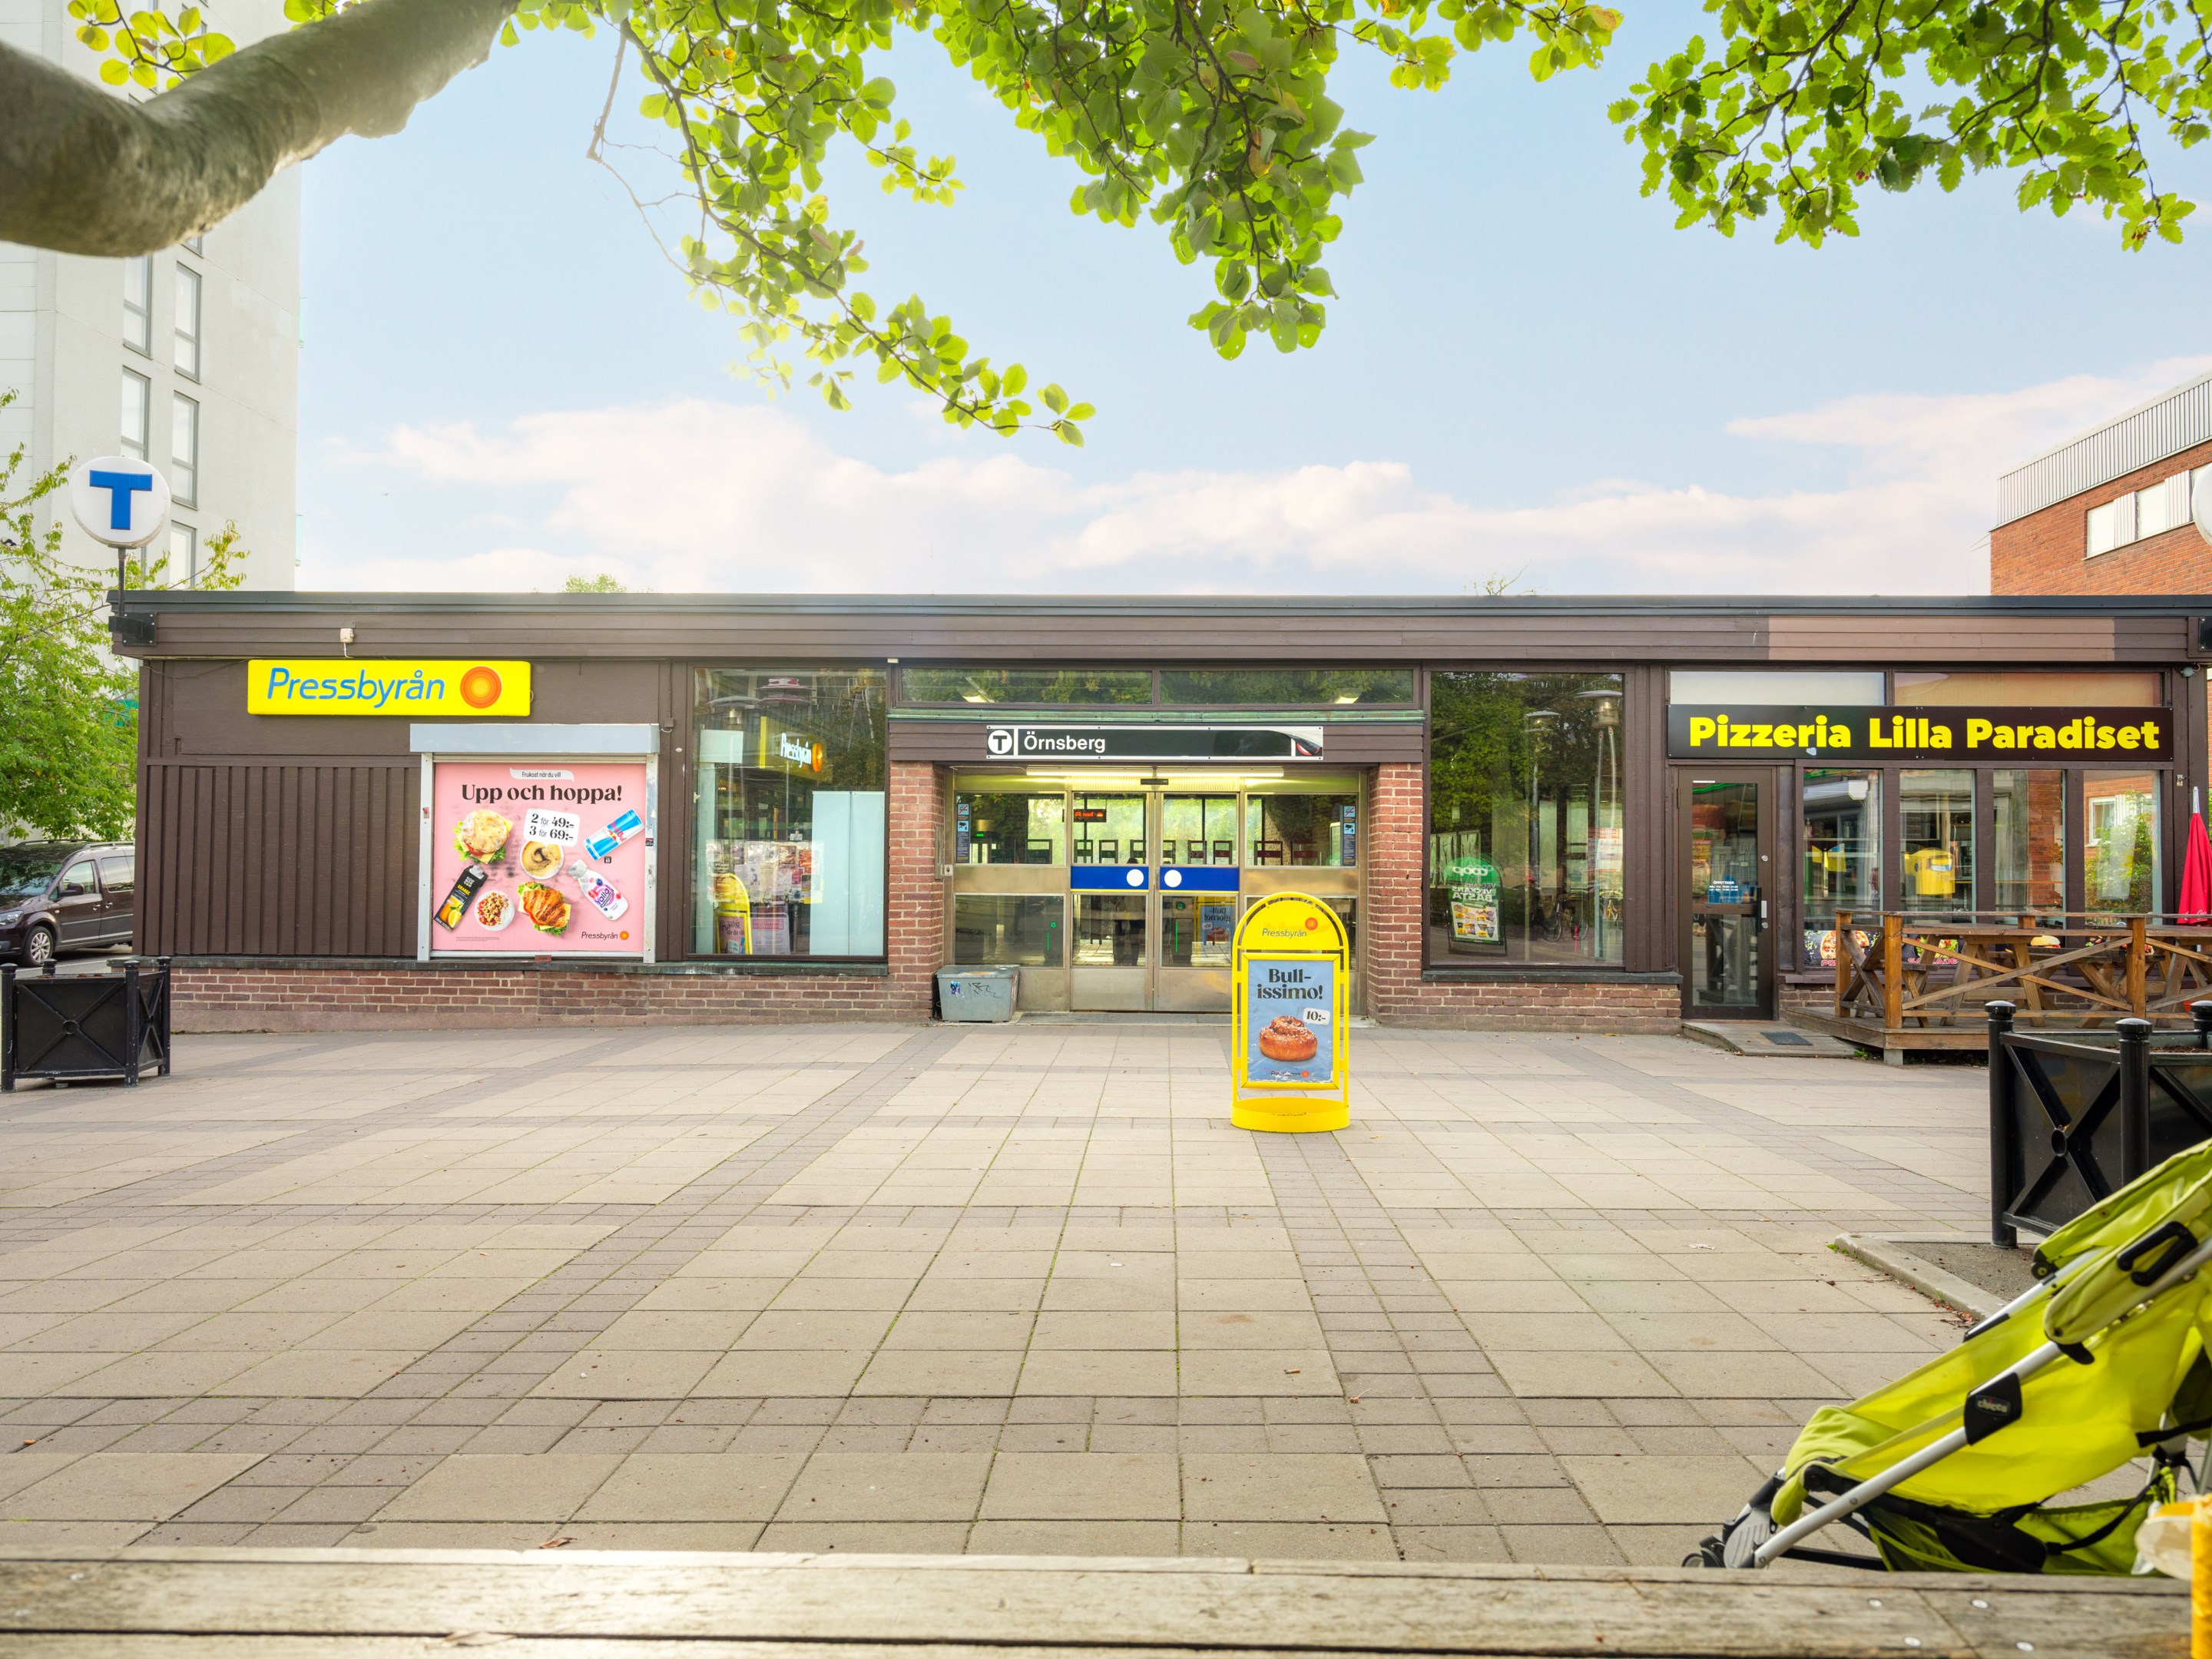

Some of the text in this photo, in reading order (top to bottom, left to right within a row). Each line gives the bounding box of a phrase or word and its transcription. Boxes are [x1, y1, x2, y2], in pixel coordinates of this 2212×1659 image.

[89, 469, 152, 531] T
[267, 667, 445, 708] Pressbyrån
[1690, 714, 2160, 750] Pizzeria Lilla Paradiset
[992, 731, 1106, 753] T Örnsberg
[462, 784, 622, 804] Upp och hoppa!
[531, 813, 575, 828] 2 för 49:-
[529, 825, 574, 840] 3 för 69:-
[581, 931, 618, 941] Pressbyrån
[1262, 928, 1307, 939] Pressbyrån
[1268, 968, 1312, 983] Bull-
[1257, 983, 1323, 1000] issimo!
[1306, 1010, 1326, 1022] 10:-
